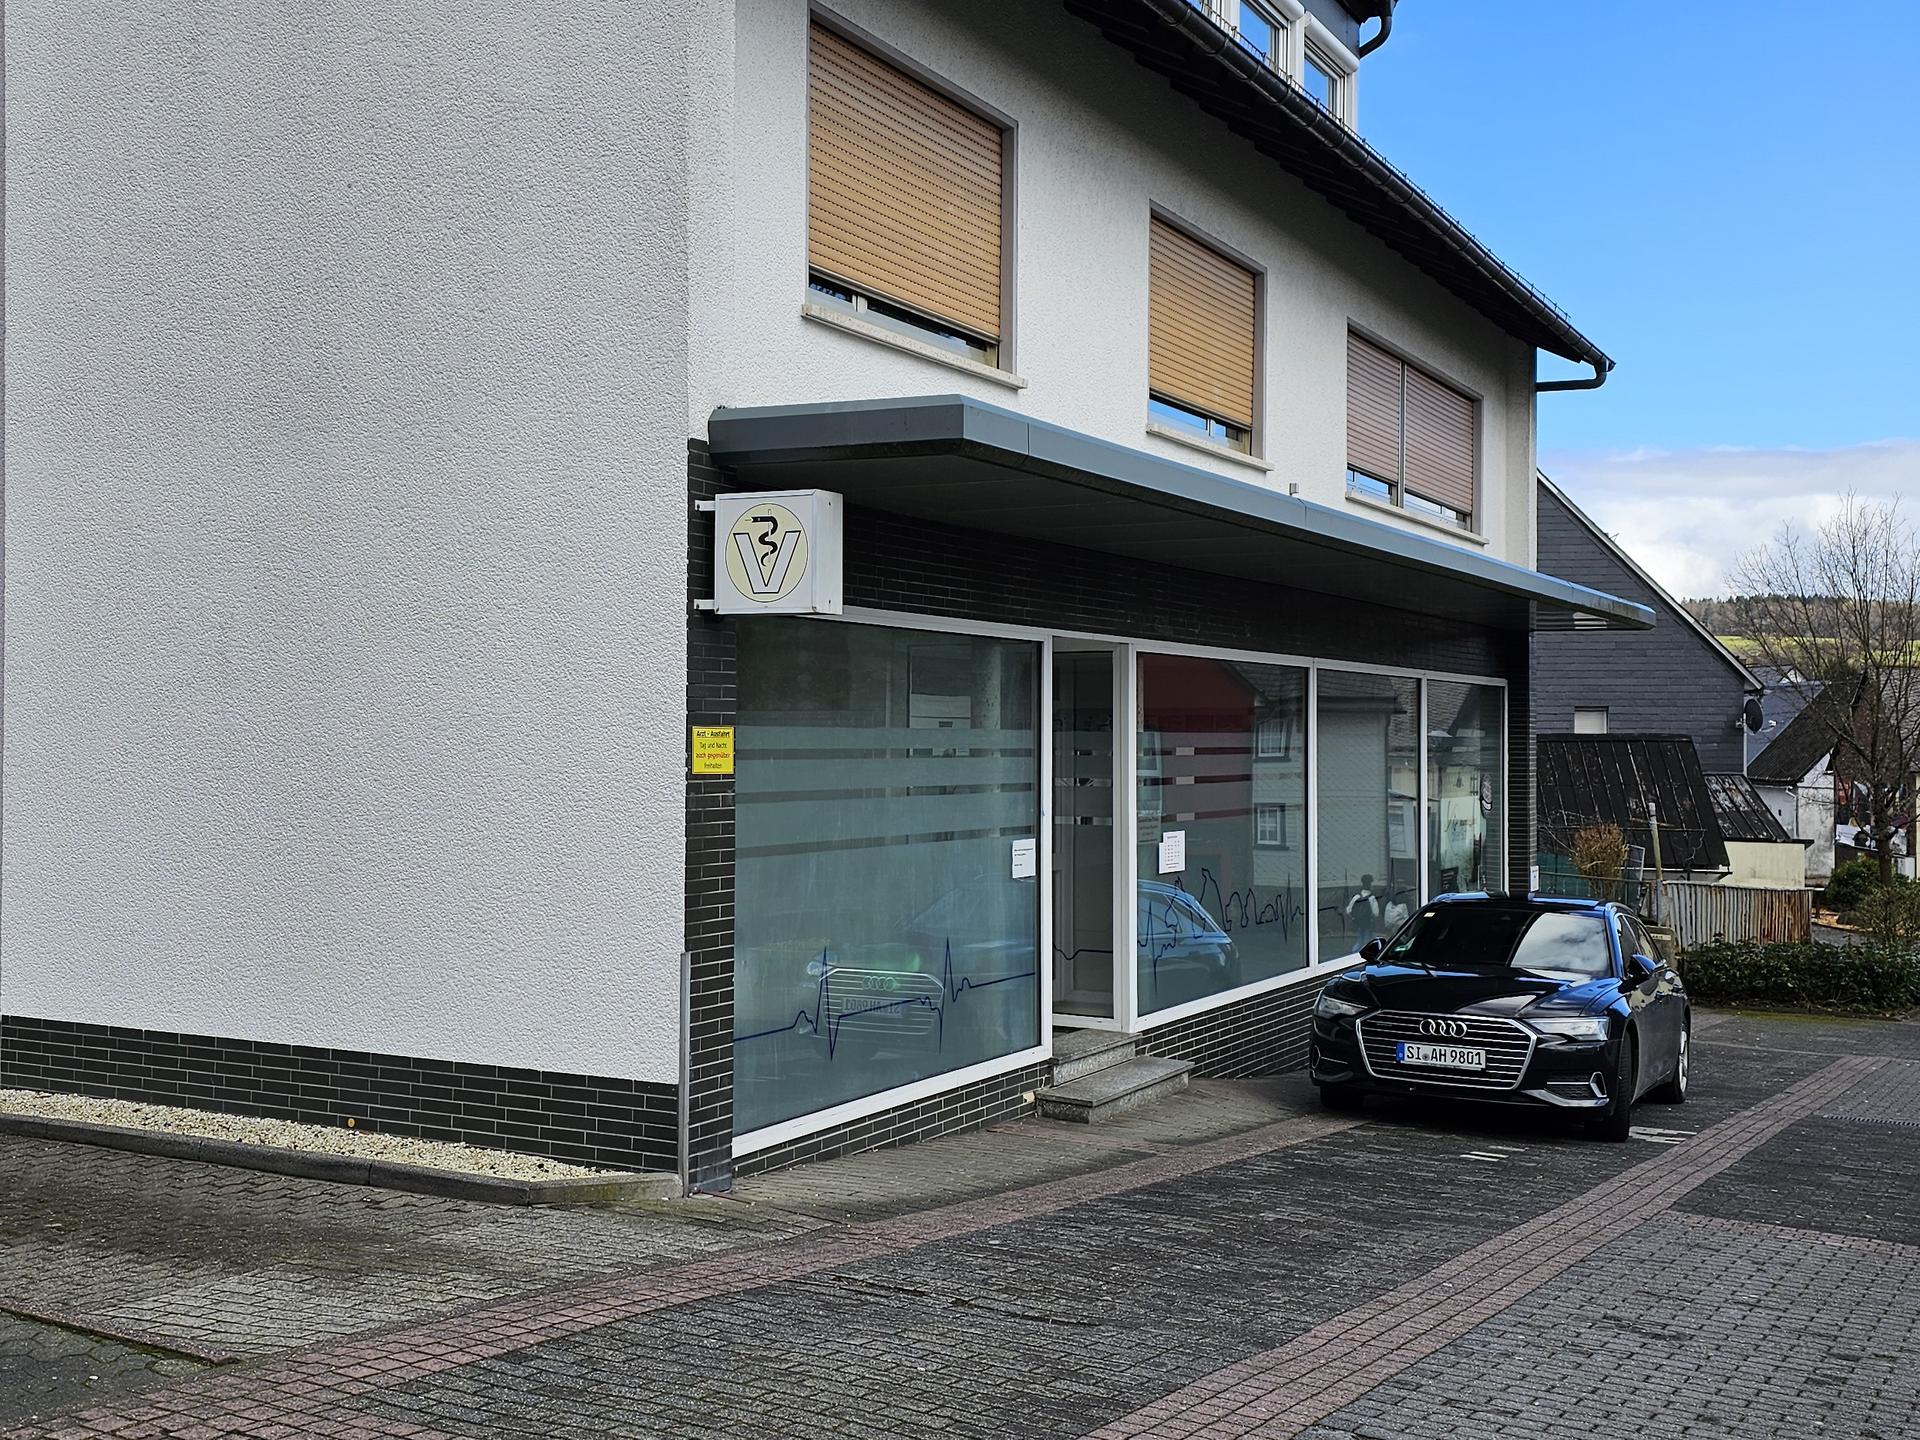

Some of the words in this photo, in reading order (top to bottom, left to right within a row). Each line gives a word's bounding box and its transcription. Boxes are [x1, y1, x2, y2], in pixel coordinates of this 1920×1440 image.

[1406, 1045, 1421, 1060] SI
[1430, 1048, 1447, 1062] AH
[1450, 1049, 1482, 1065] 9801
